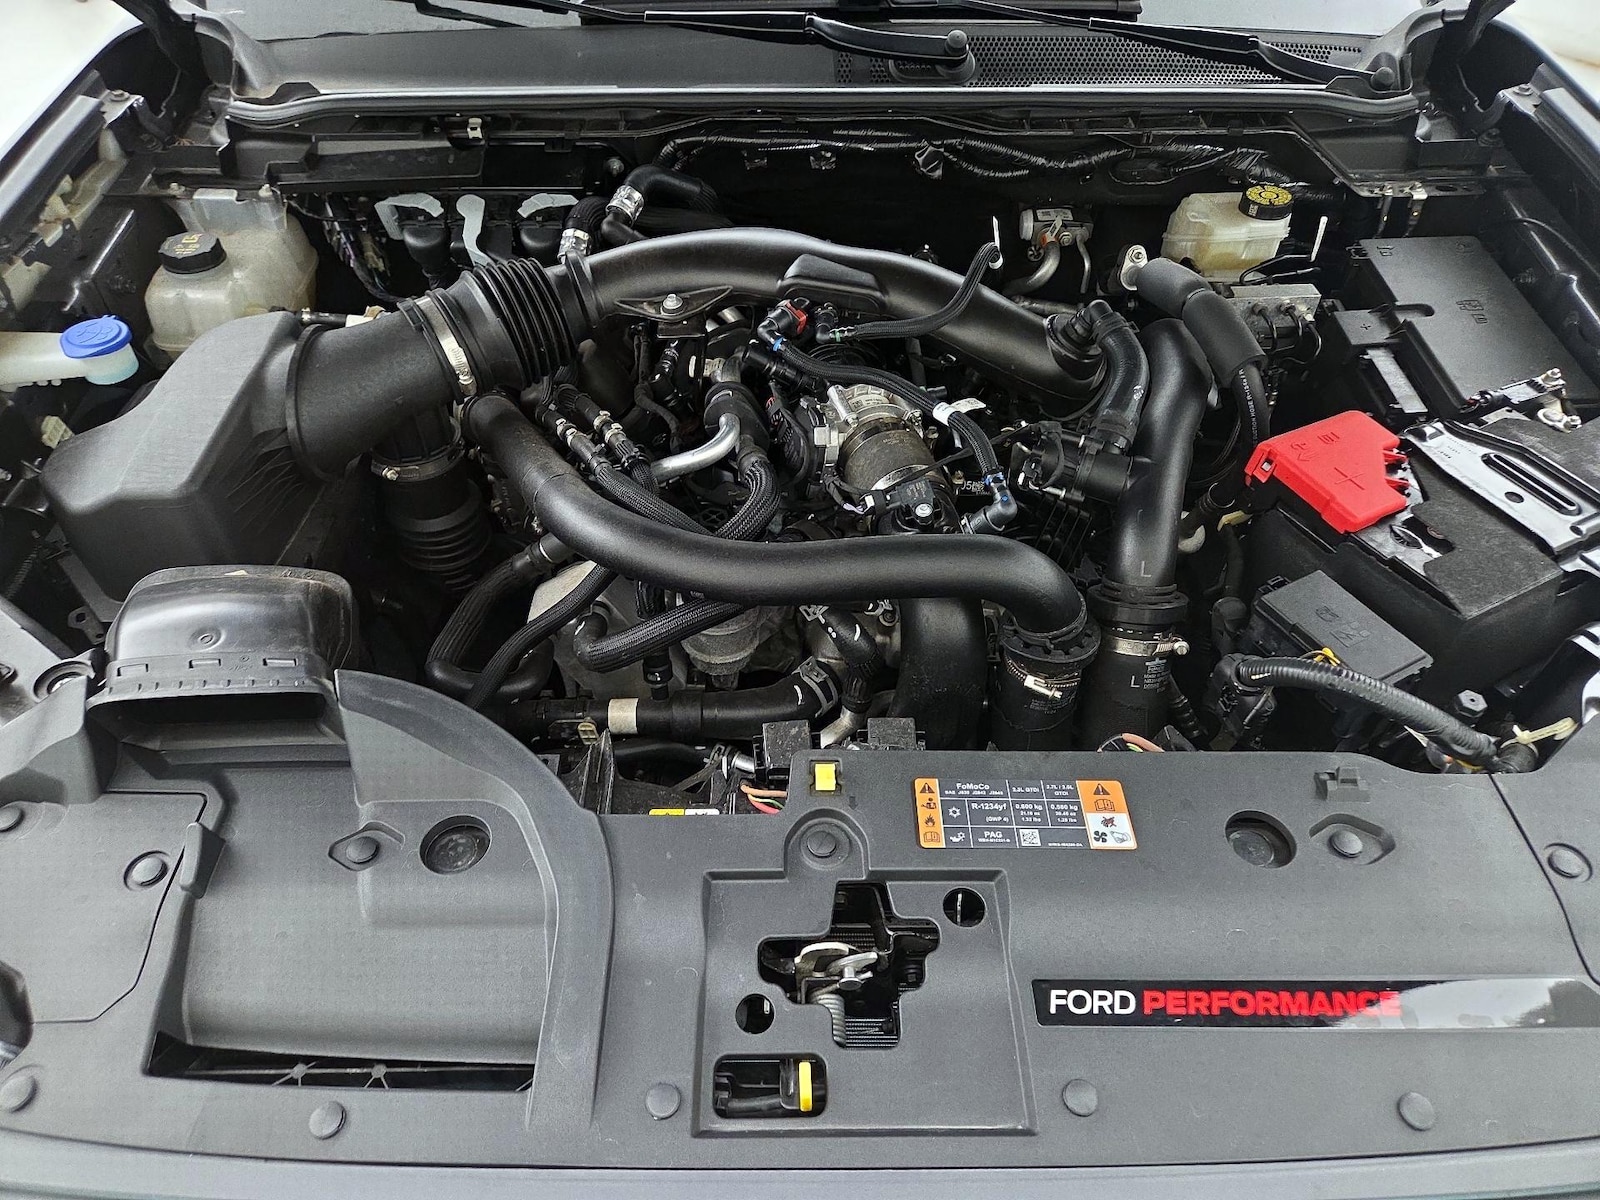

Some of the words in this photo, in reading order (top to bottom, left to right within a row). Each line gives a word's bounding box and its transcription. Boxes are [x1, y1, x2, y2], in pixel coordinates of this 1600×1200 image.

[1130, 675, 1140, 688] L
[971, 803, 1007, 811] R-1234yf
[1049, 989, 1137, 1015] FORD
[1142, 989, 1402, 1017] PERFORMANCE
